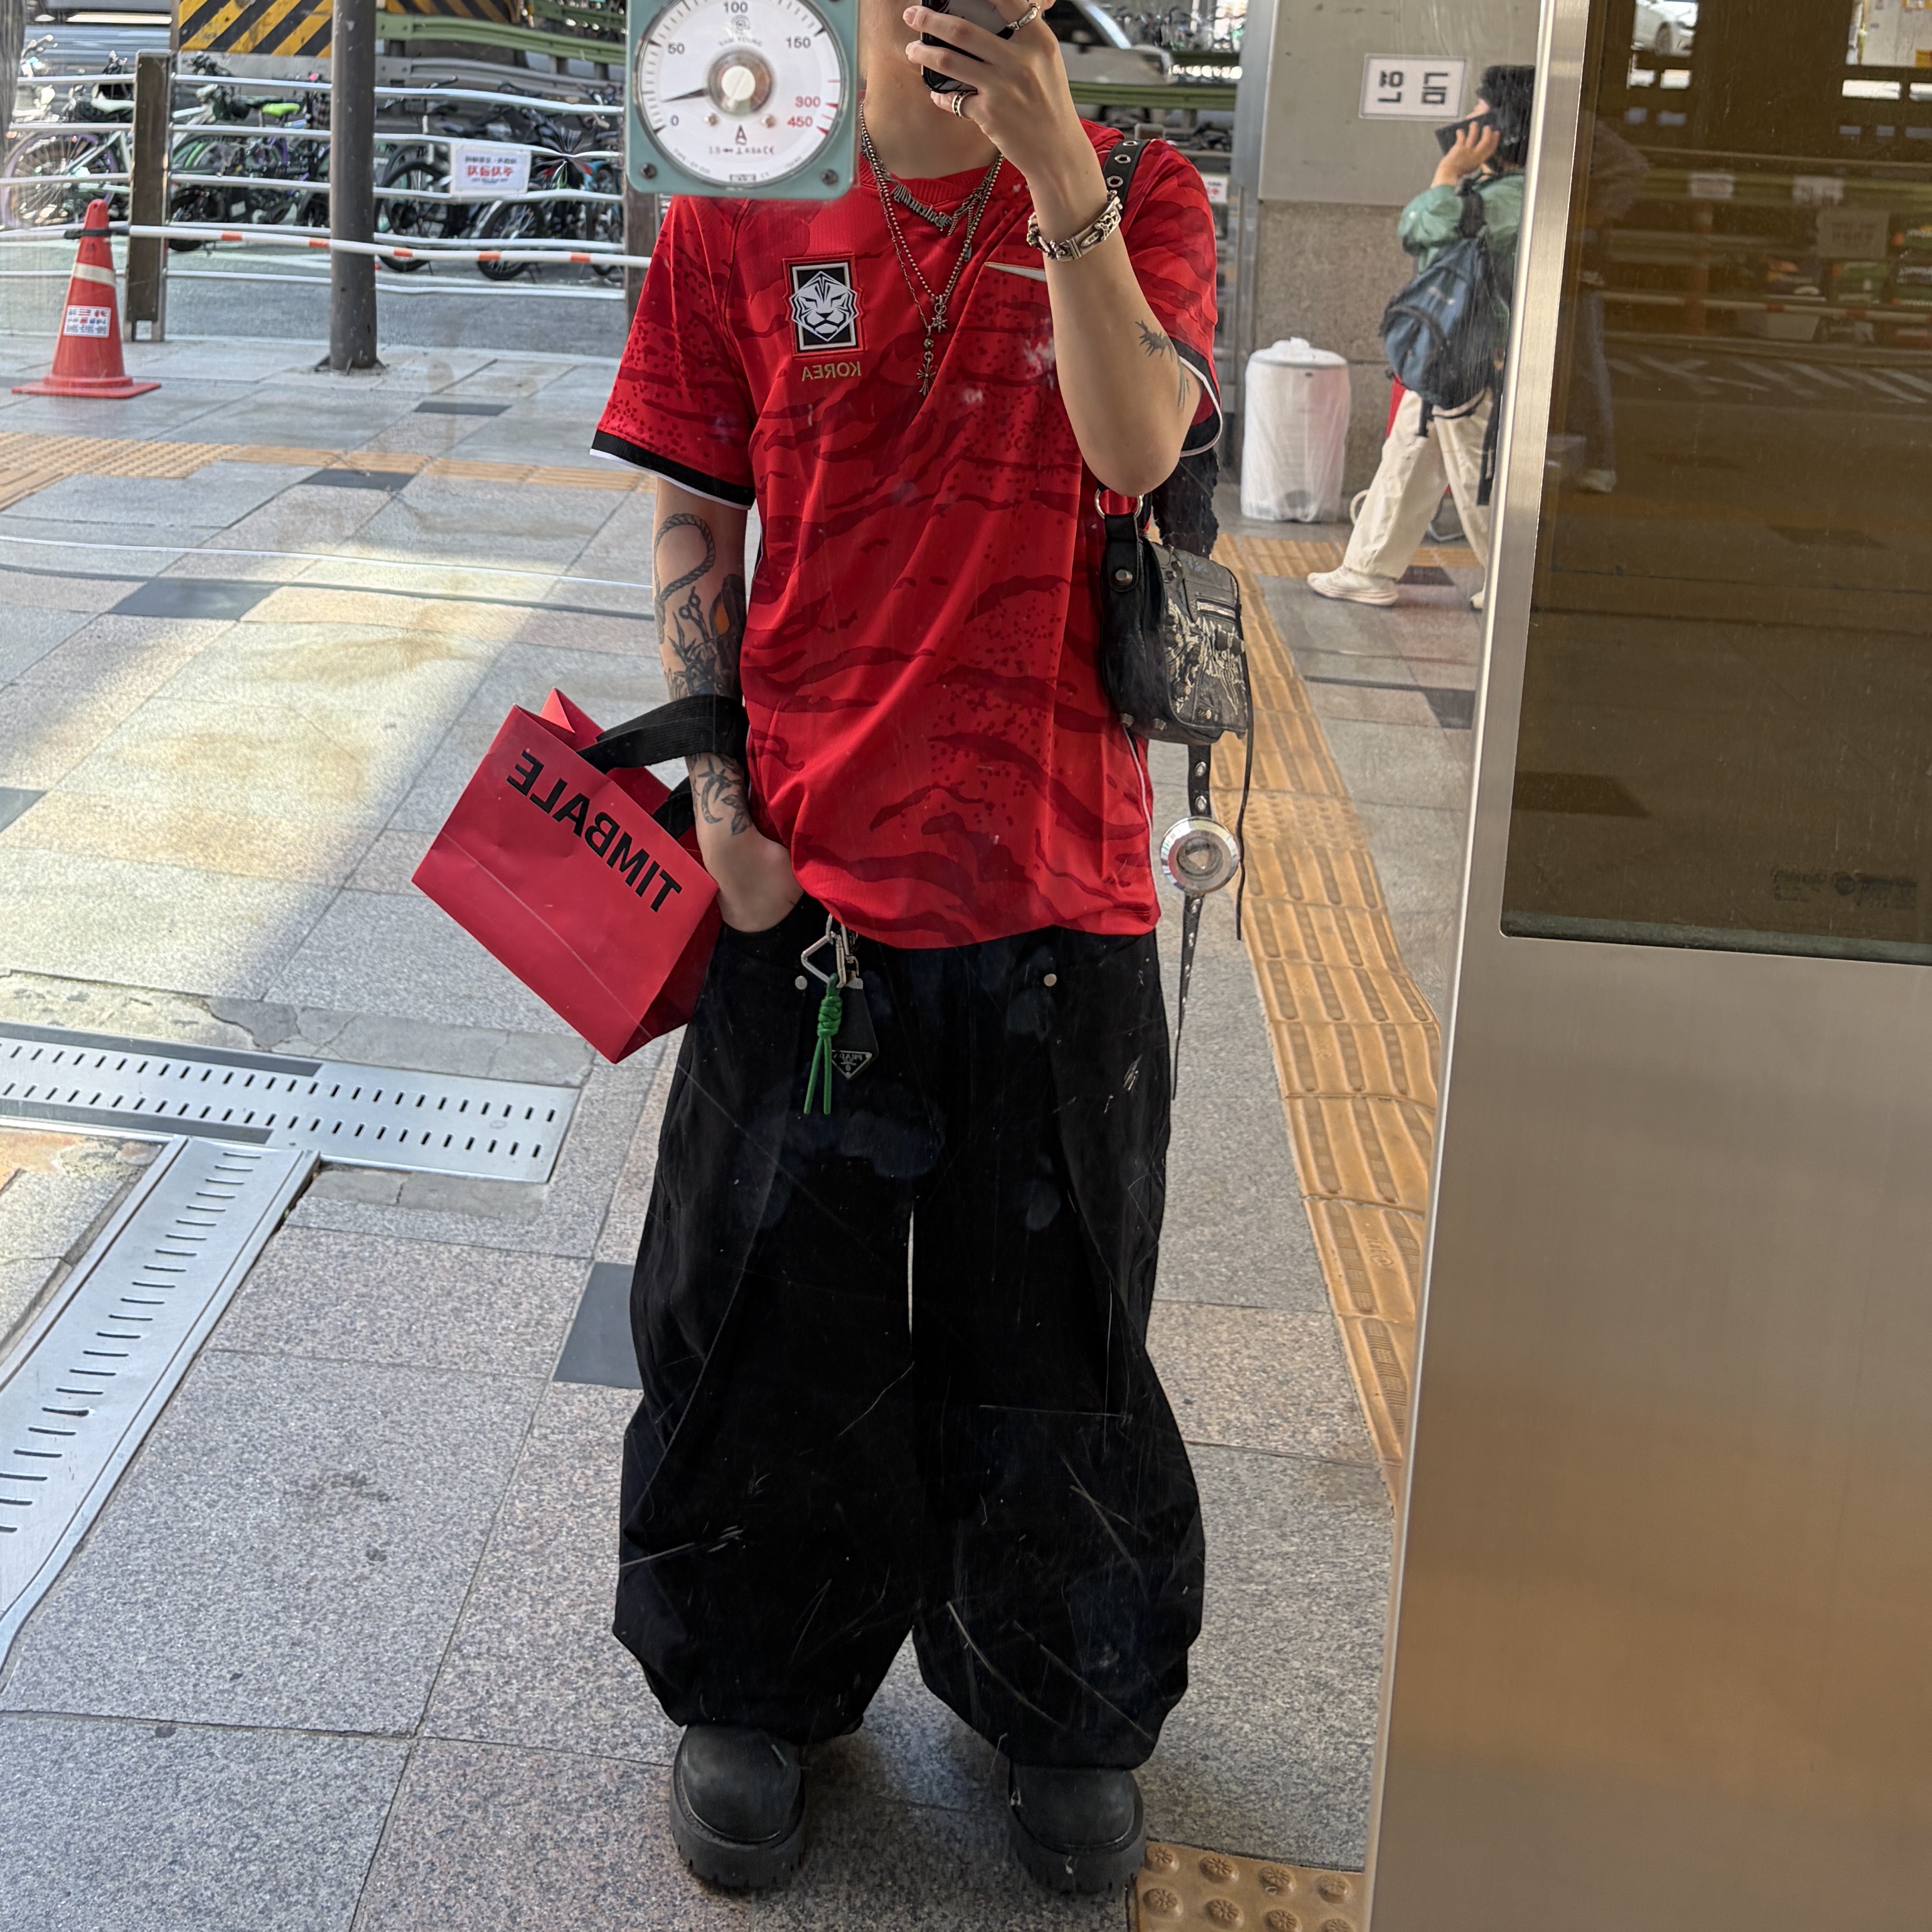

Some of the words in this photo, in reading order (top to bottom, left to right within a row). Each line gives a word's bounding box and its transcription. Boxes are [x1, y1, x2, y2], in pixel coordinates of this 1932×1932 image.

[724, 2, 748, 14] 100
[787, 36, 811, 48] 150
[668, 43, 685, 55] 50
[795, 96, 821, 108] 300
[671, 115, 679, 126] 0
[788, 116, 814, 128] 450
[735, 124, 747, 145] A
